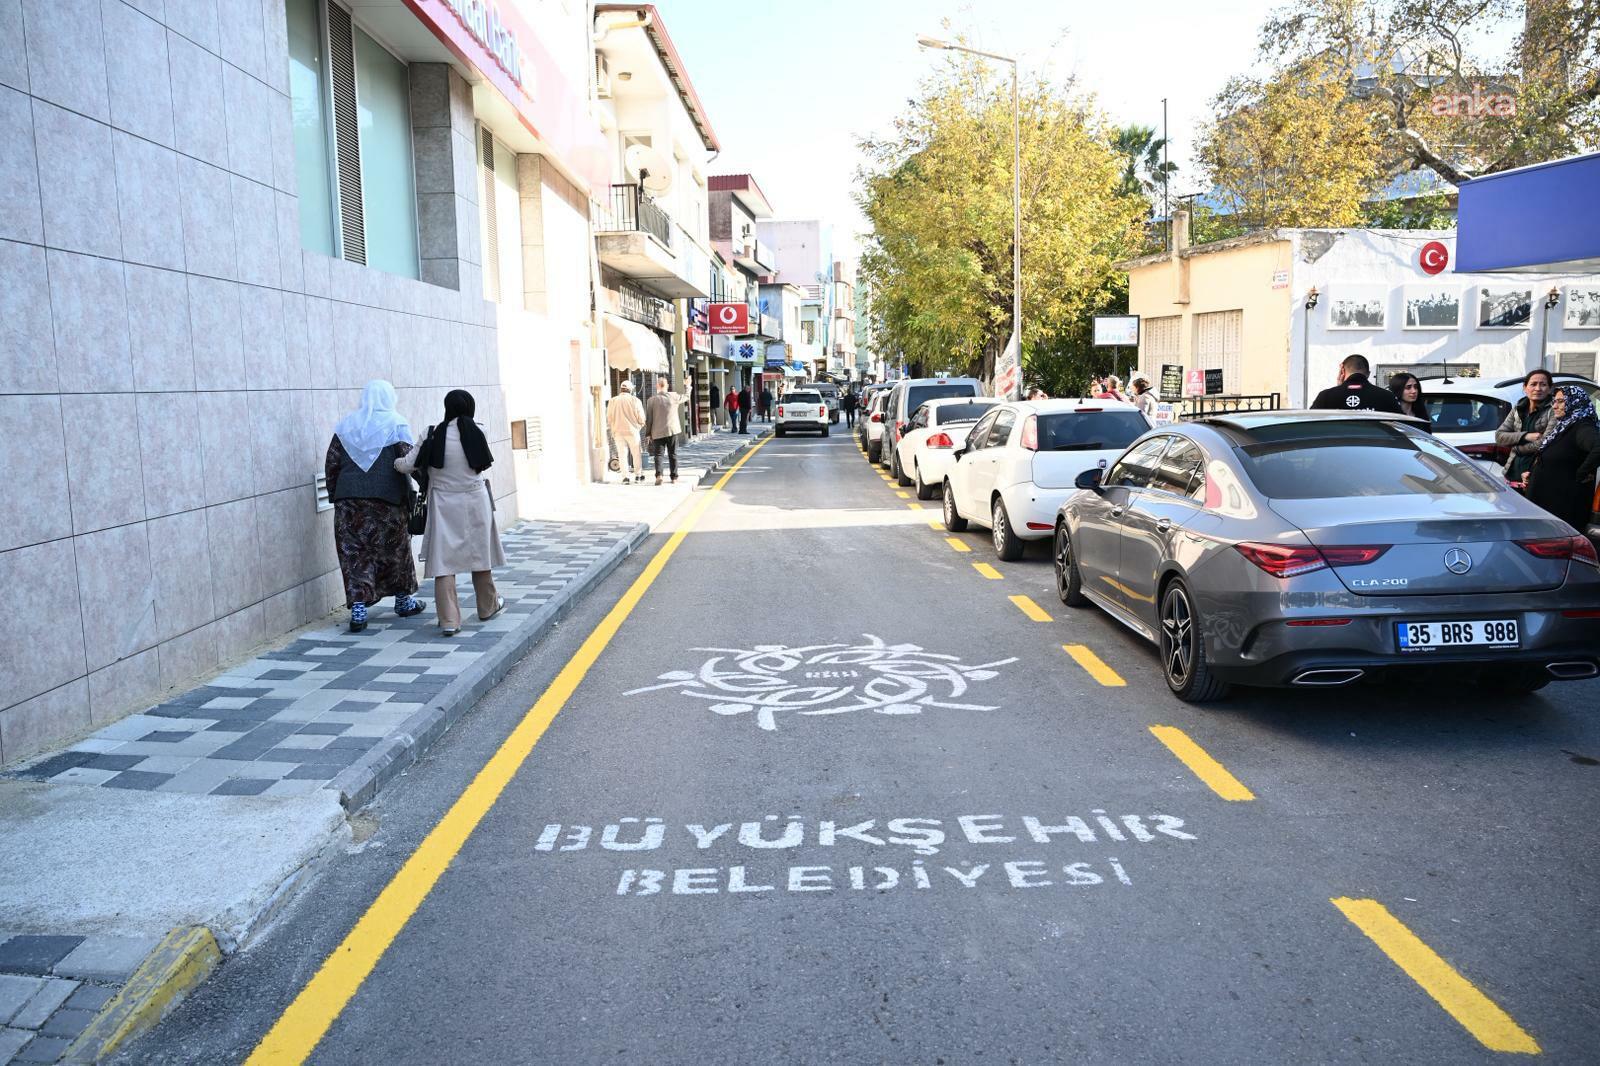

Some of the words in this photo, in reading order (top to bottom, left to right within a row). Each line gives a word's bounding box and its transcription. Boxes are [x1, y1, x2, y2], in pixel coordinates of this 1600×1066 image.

[1382, 578, 1408, 586] 200
[1409, 624, 1431, 645] 35
[1441, 623, 1474, 644] BRS
[1484, 621, 1517, 642] 988
[534, 809, 1198, 855] BÜYÜKŞEHİR
[616, 857, 1133, 898] BELEDİYESİ
